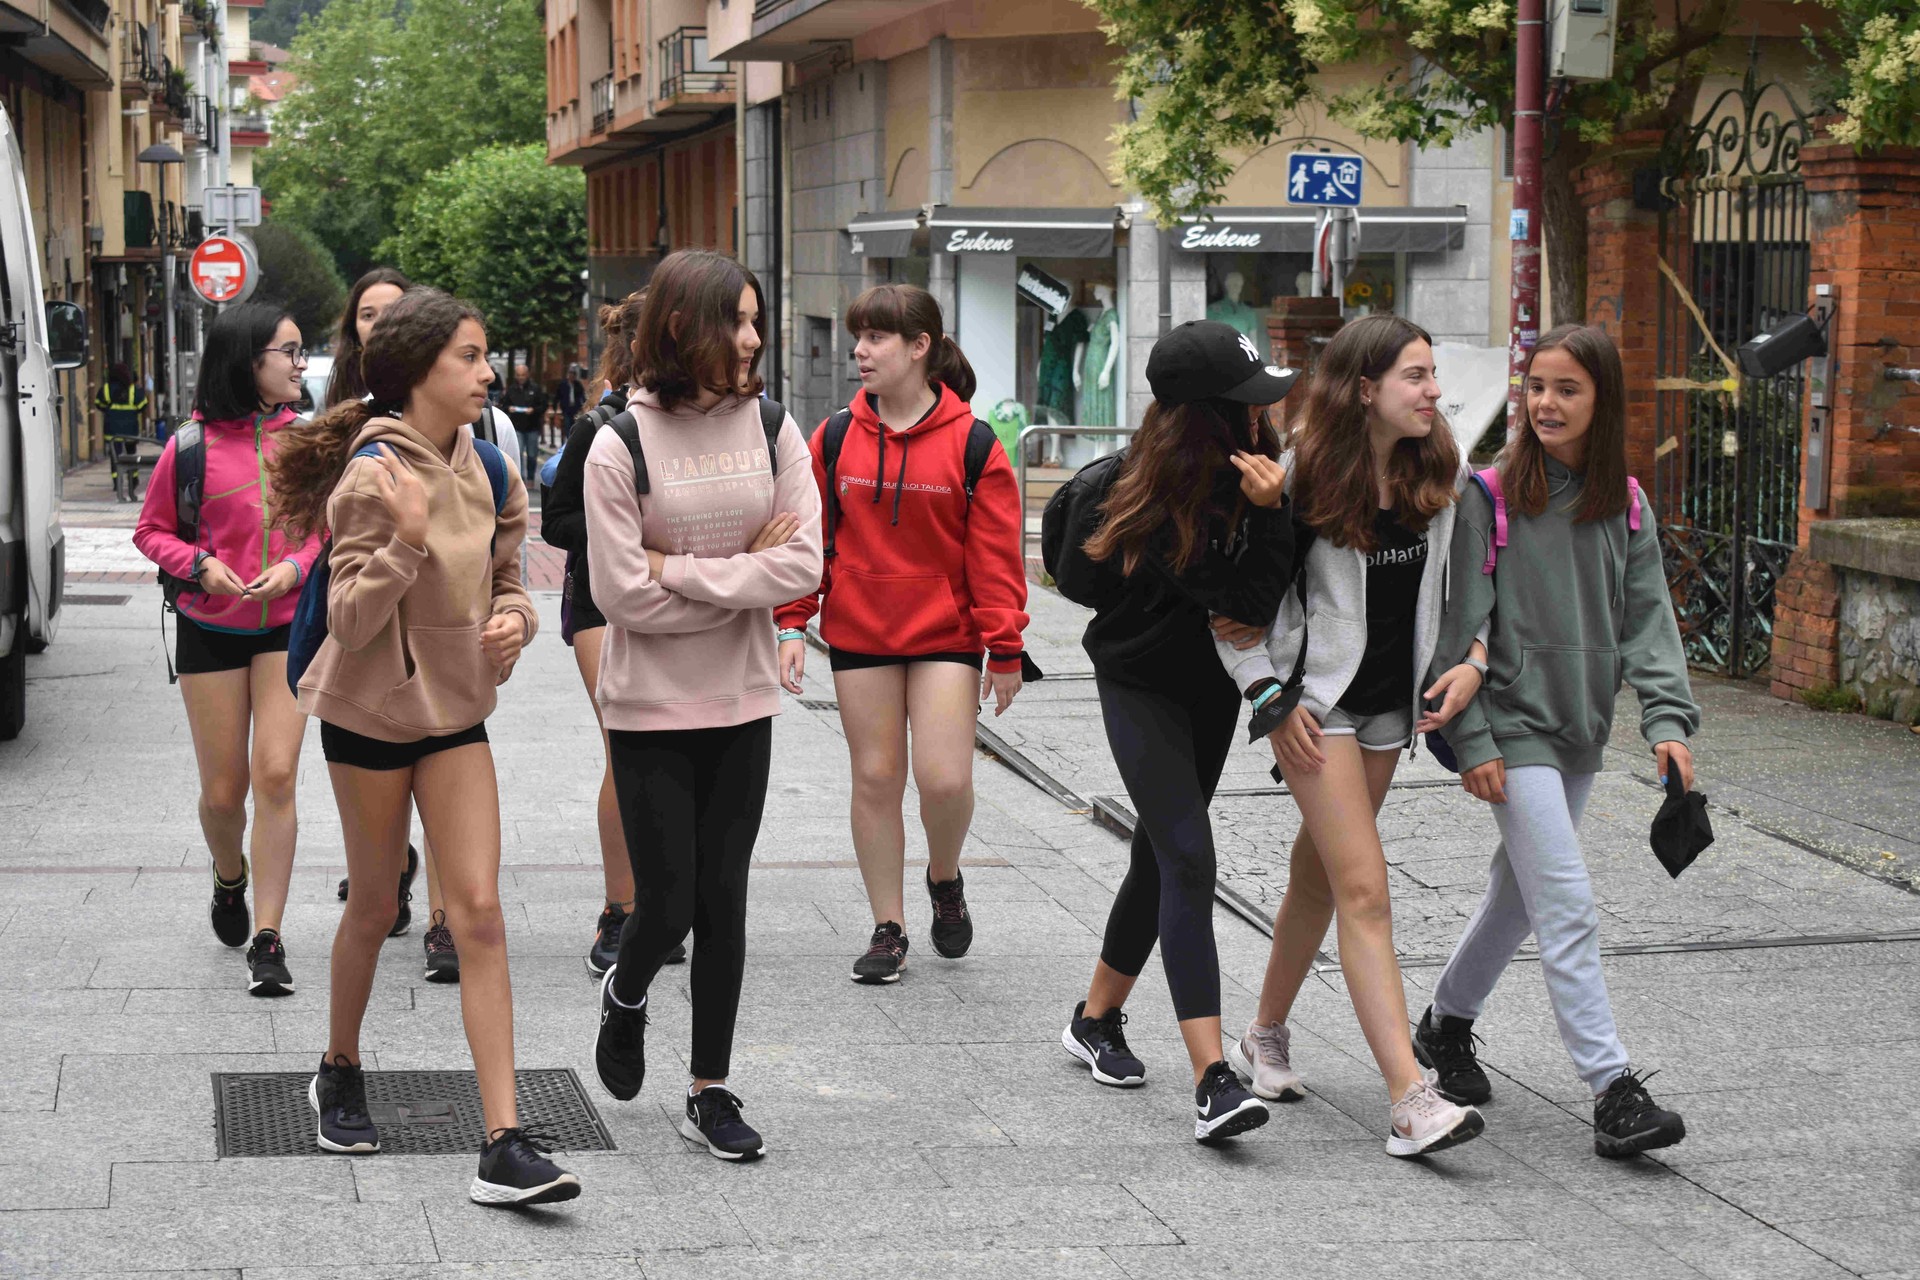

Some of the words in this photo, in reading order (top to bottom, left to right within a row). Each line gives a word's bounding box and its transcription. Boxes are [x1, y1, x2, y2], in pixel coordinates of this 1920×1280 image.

[946, 229, 1014, 252] Eukene
[1181, 225, 1261, 249] Eukene
[659, 448, 769, 480] L'AMOUR
[840, 475, 870, 485] HERNANI
[922, 484, 952, 492] TALDEA
[682, 512, 712, 522] MEANING
[725, 509, 743, 517] LOVE
[667, 526, 688, 534] LOVE
[704, 520, 743, 530] SOMEONE
[687, 534, 710, 542] MEANS
[722, 540, 741, 548] SMILE
